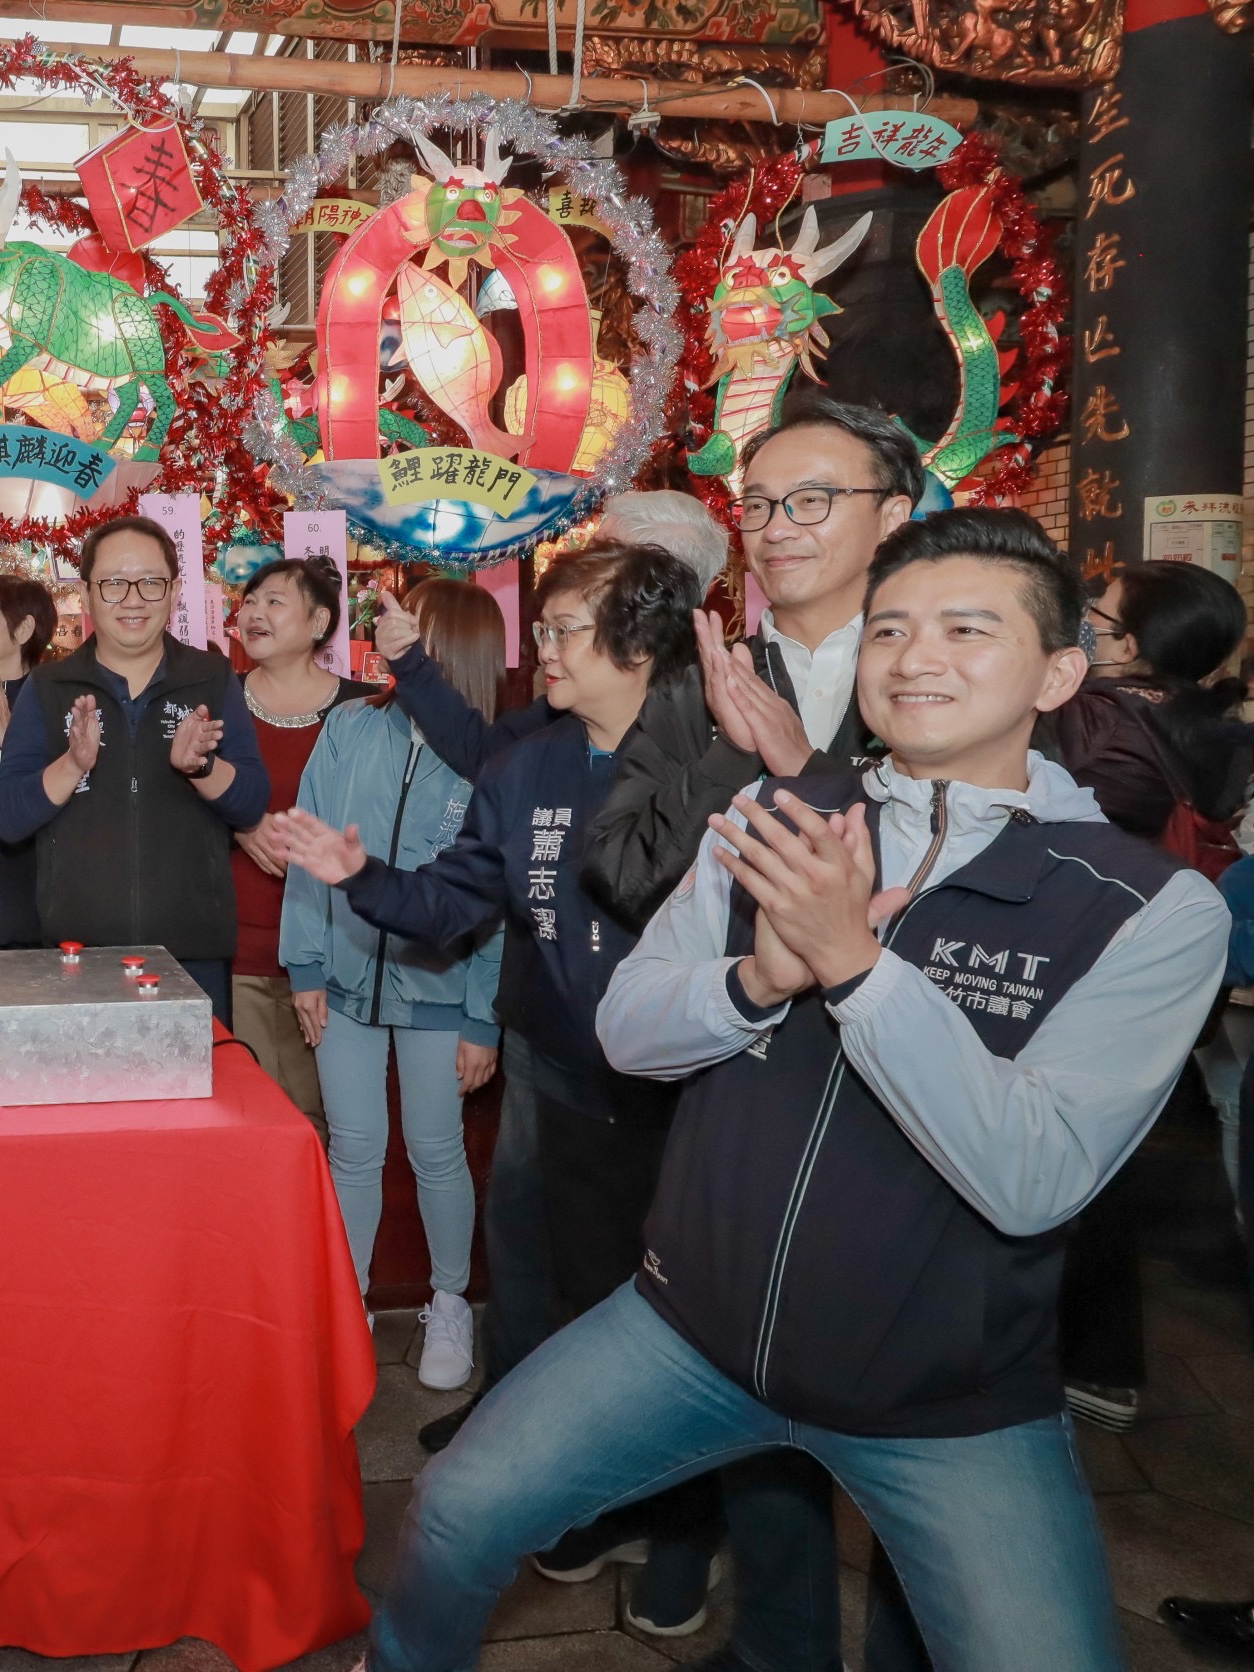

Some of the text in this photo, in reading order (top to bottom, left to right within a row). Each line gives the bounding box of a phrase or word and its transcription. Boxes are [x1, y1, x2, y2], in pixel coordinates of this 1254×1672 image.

[837, 120, 948, 161] 吉祥龍年
[118, 136, 180, 234] 春
[387, 452, 522, 501] 鯉躍龍門
[531, 807, 573, 828] 議員
[929, 937, 1051, 981] KMT
[923, 965, 1045, 1001] KEEP MOVING TAIWAN
